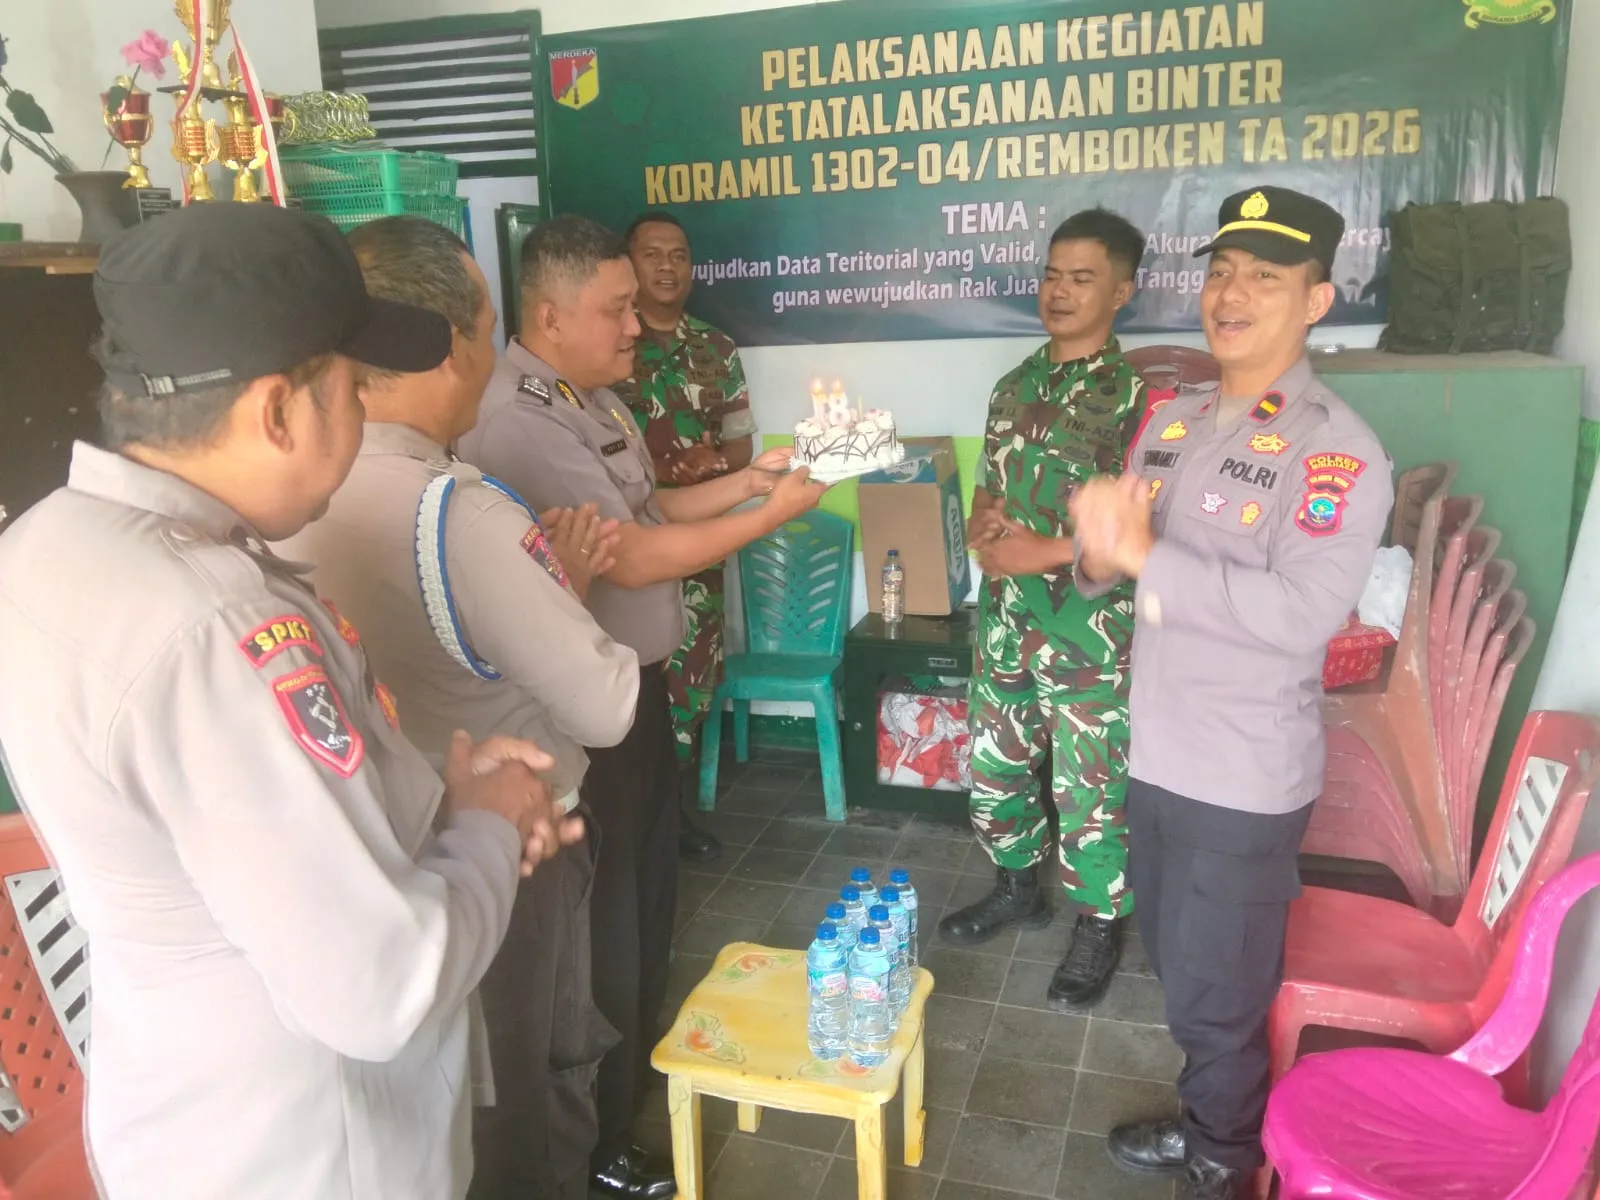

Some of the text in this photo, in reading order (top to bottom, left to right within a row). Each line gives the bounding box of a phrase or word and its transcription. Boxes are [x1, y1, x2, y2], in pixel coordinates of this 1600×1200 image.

[762, 1, 1265, 92] PELAKSANAAN KEGIATAN
[740, 58, 1283, 147] KETATALAKSANAAN BINTER
[645, 109, 1422, 206] KORAMIL 1302-04/REMBOKEN TA 2026
[941, 200, 1046, 236] TEMA :
[777, 254, 821, 277] Data
[826, 247, 918, 274] Teritorial
[923, 247, 974, 275] yang
[979, 239, 1041, 266] Valid,
[772, 289, 820, 314] guna
[825, 279, 954, 310] wewujudkan
[959, 276, 999, 299] Rak
[1219, 456, 1277, 490] POLRI
